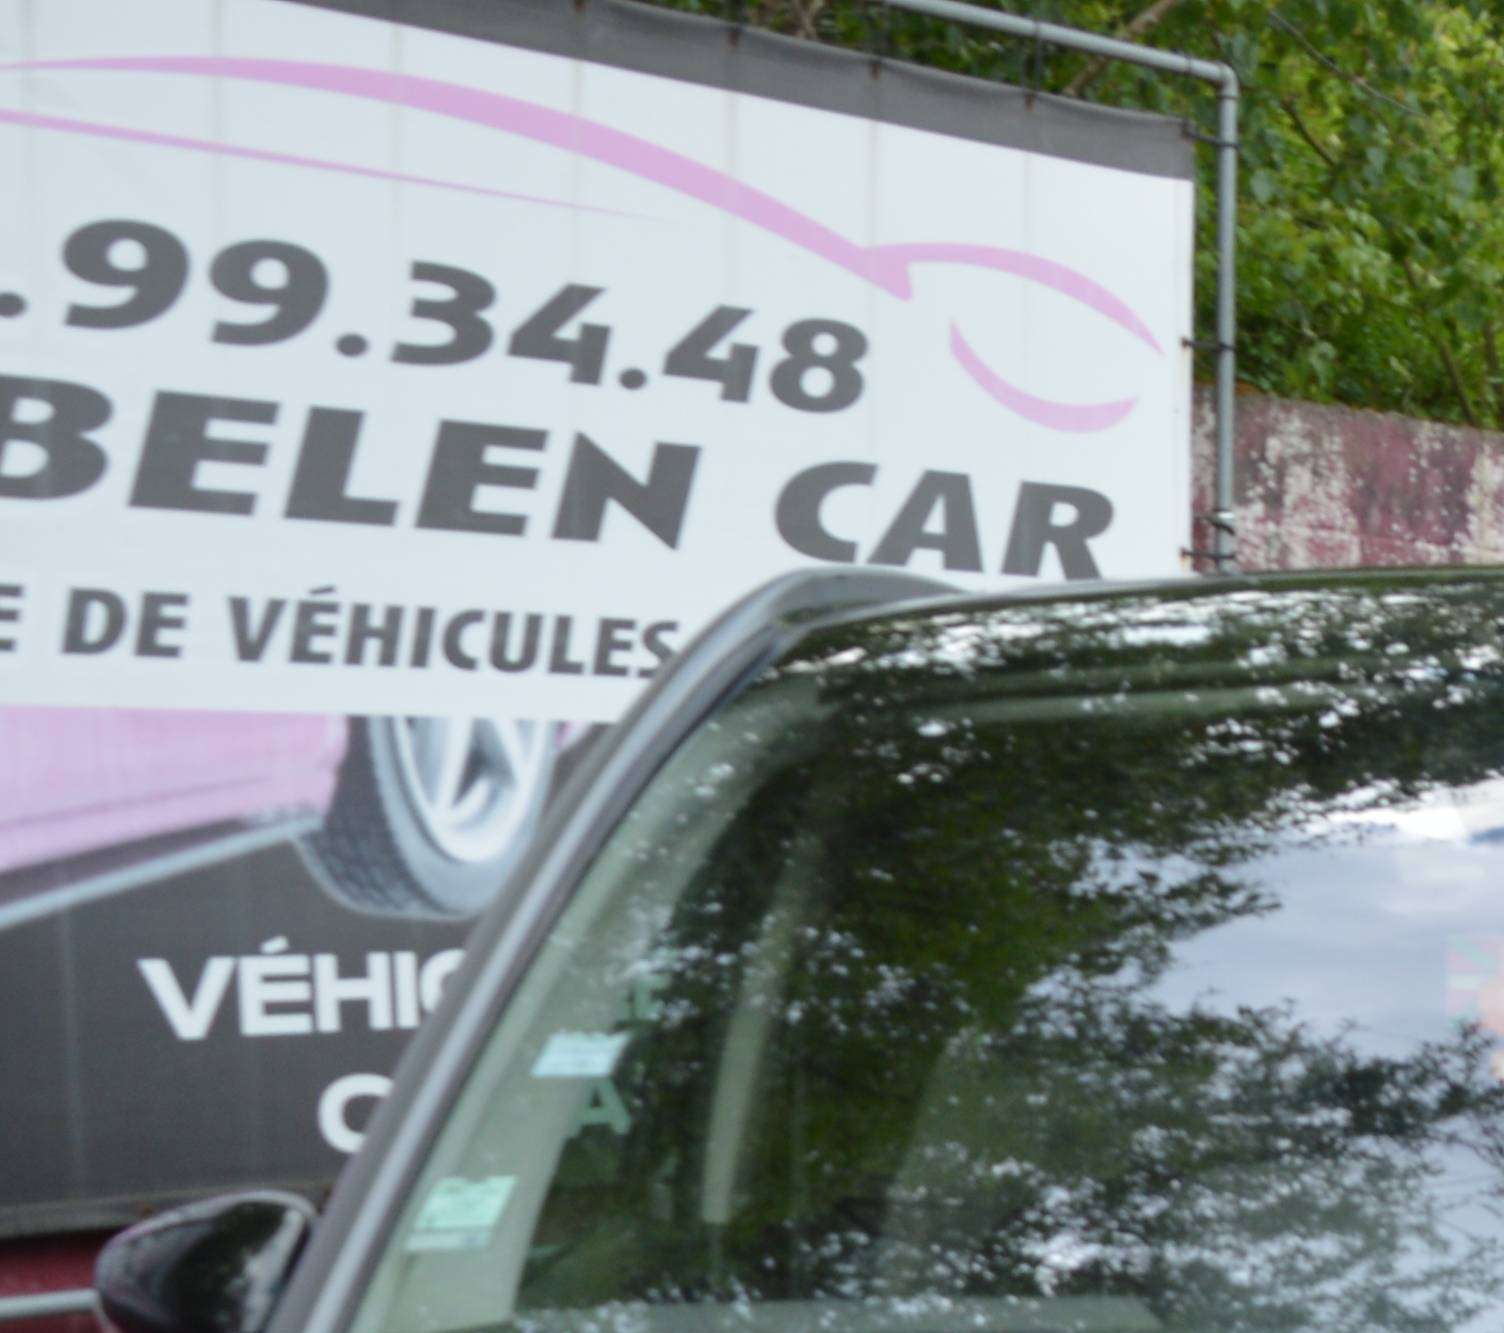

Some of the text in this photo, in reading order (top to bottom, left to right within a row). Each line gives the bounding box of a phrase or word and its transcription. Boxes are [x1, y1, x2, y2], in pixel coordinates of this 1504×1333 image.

[773, 460, 1114, 580] CAR
[62, 587, 190, 660] DE
[227, 586, 680, 680] VÉHICULES
